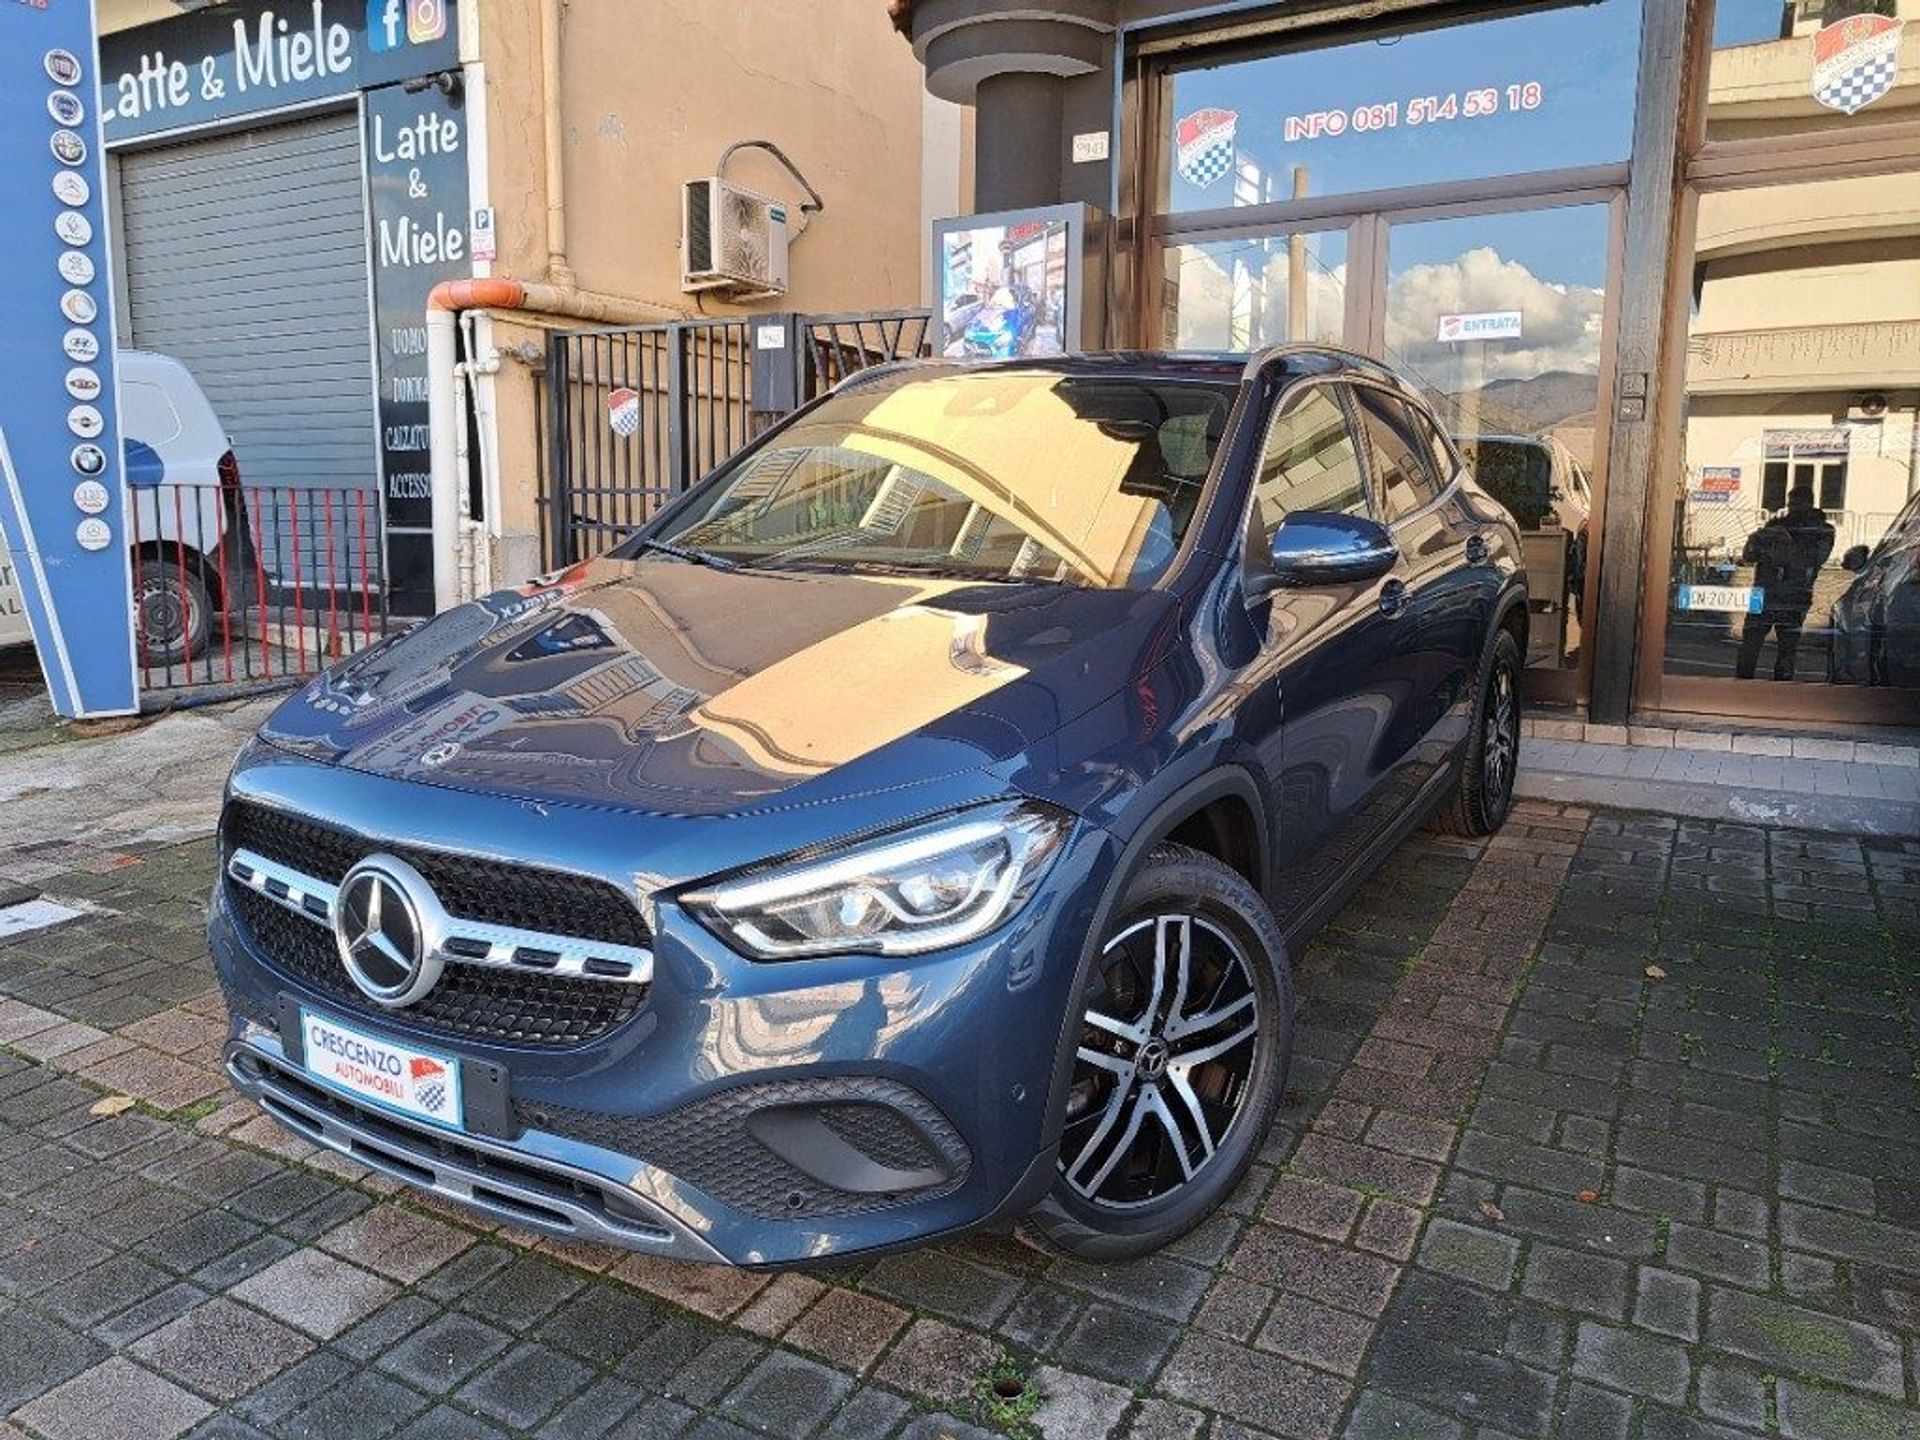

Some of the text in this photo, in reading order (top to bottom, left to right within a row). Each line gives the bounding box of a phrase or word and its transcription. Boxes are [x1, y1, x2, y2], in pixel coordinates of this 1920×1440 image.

[101, 0, 352, 123] atte & Miele
[1284, 82, 1542, 142] INFO 081 514 53 18
[375, 112, 459, 163] Latte
[408, 167, 428, 199] &
[379, 211, 464, 268] Miele
[391, 327, 427, 354] UOMO
[1463, 316, 1520, 332] ENTRATA
[393, 376, 429, 403] DONNA
[311, 1025, 403, 1076] CRESCENZO
[335, 1061, 405, 1100] AUTOMOBILI
